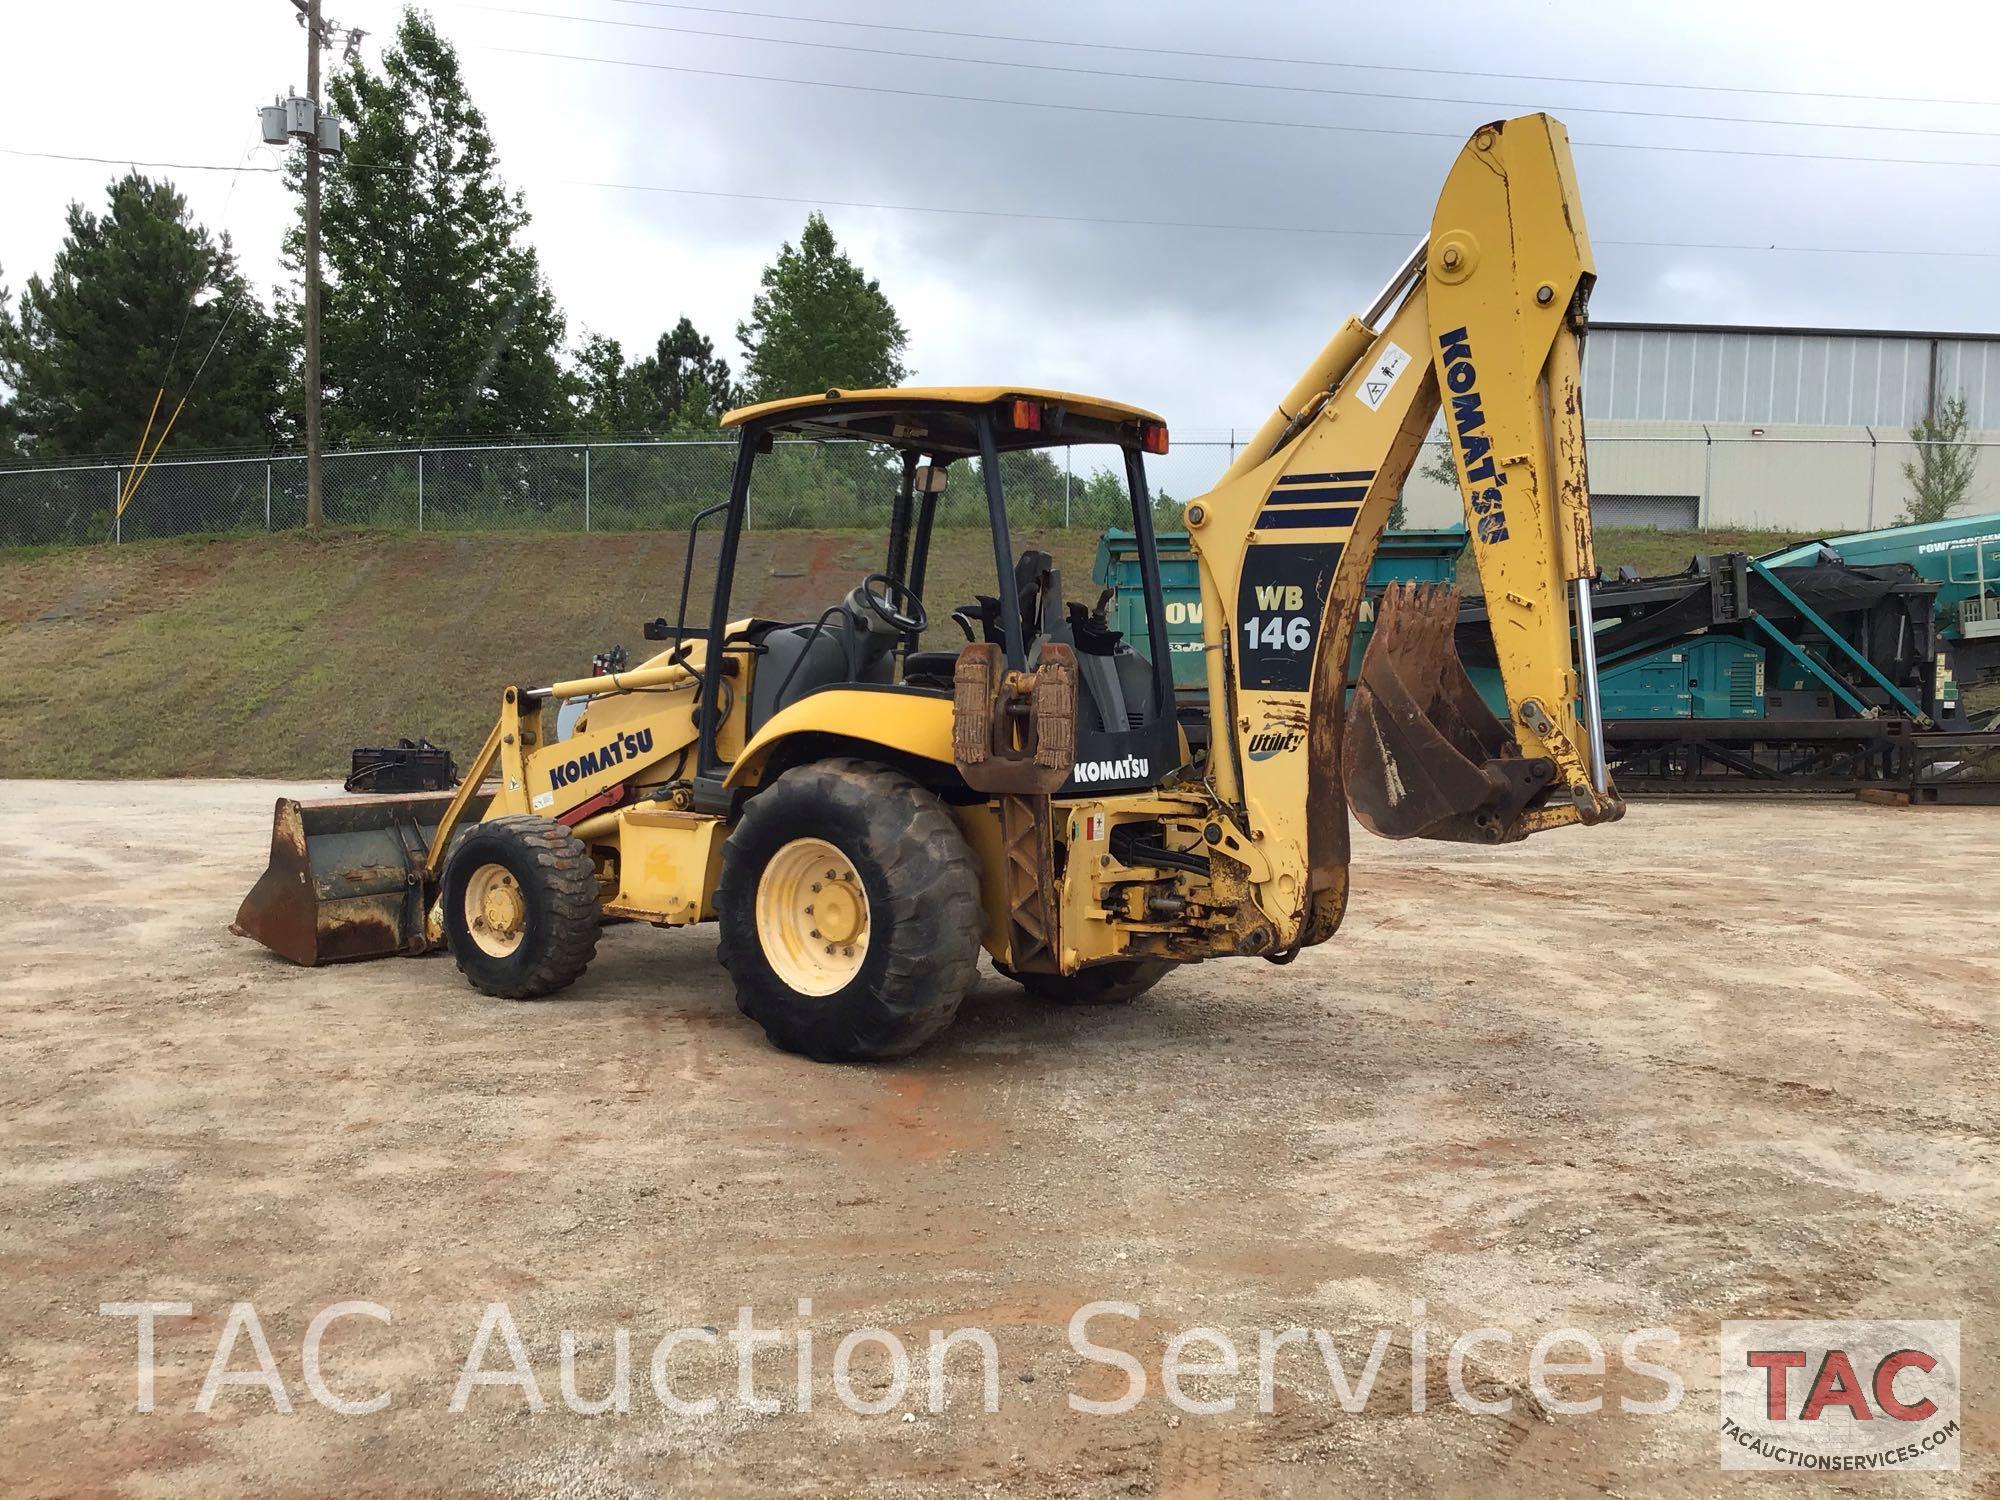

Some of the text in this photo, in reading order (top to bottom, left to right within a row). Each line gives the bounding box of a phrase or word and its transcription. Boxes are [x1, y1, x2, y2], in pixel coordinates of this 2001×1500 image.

[1438, 326, 1509, 545] KOMATSU
[1255, 586, 1304, 611] WB
[1244, 616, 1311, 651] 146
[1248, 732, 1305, 753] Utility
[549, 727, 654, 791] KOMATSU
[1073, 753, 1149, 783] KOMATSU
